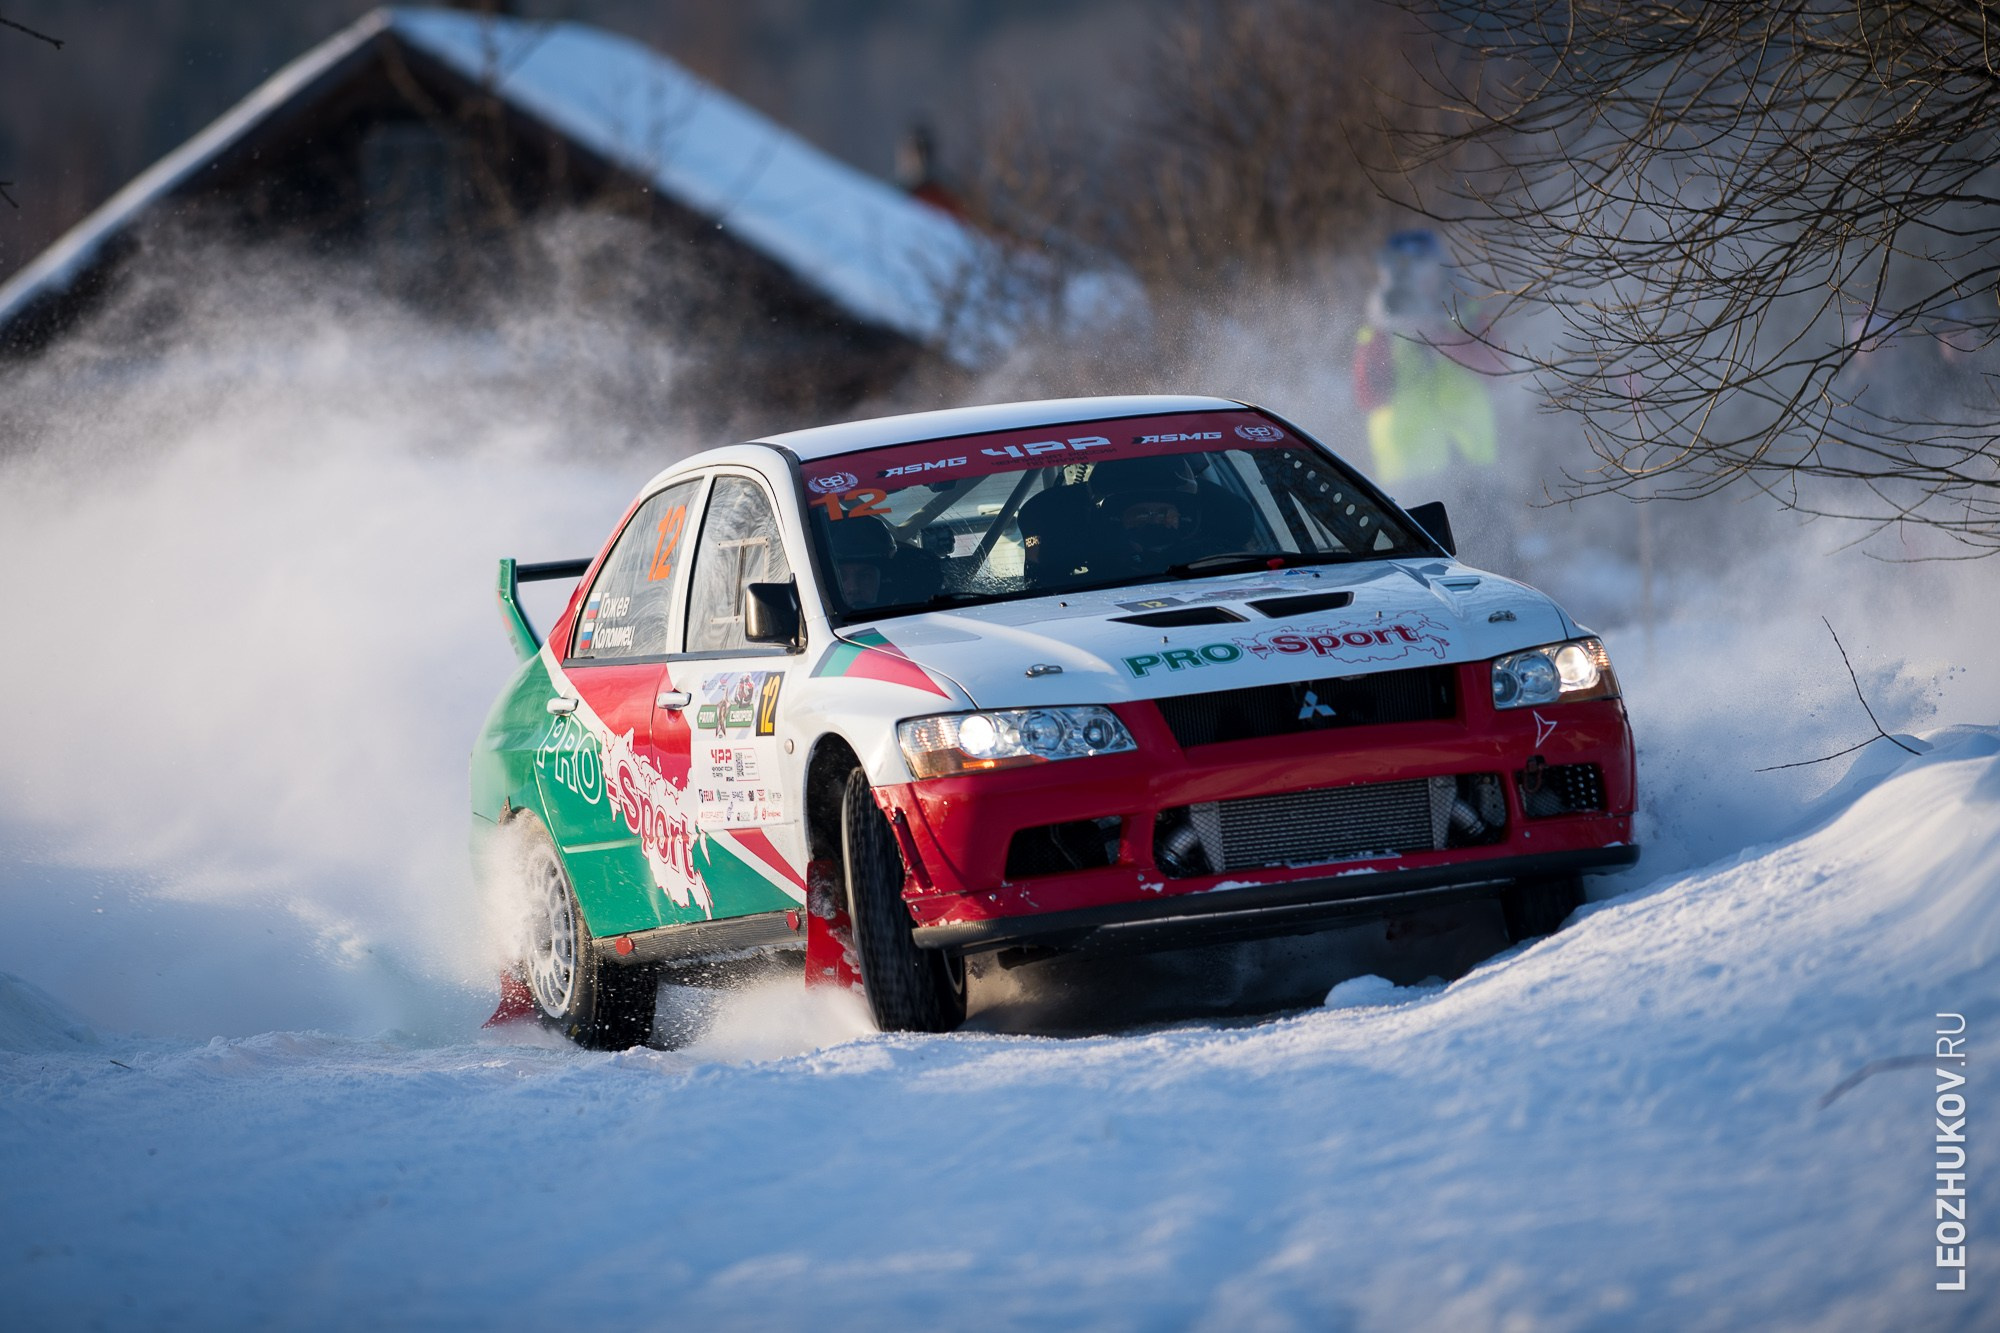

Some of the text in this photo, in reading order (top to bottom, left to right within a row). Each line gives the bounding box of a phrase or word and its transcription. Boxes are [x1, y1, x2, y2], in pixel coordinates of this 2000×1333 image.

[1141, 431, 1222, 444] ASMG
[885, 457, 967, 478] ASMG
[809, 488, 892, 521] 12
[648, 504, 696, 582] 12
[598, 592, 630, 619] Гожев
[1137, 600, 1168, 609] 12
[591, 623, 636, 650] Коломиец
[761, 675, 781, 733] 12
